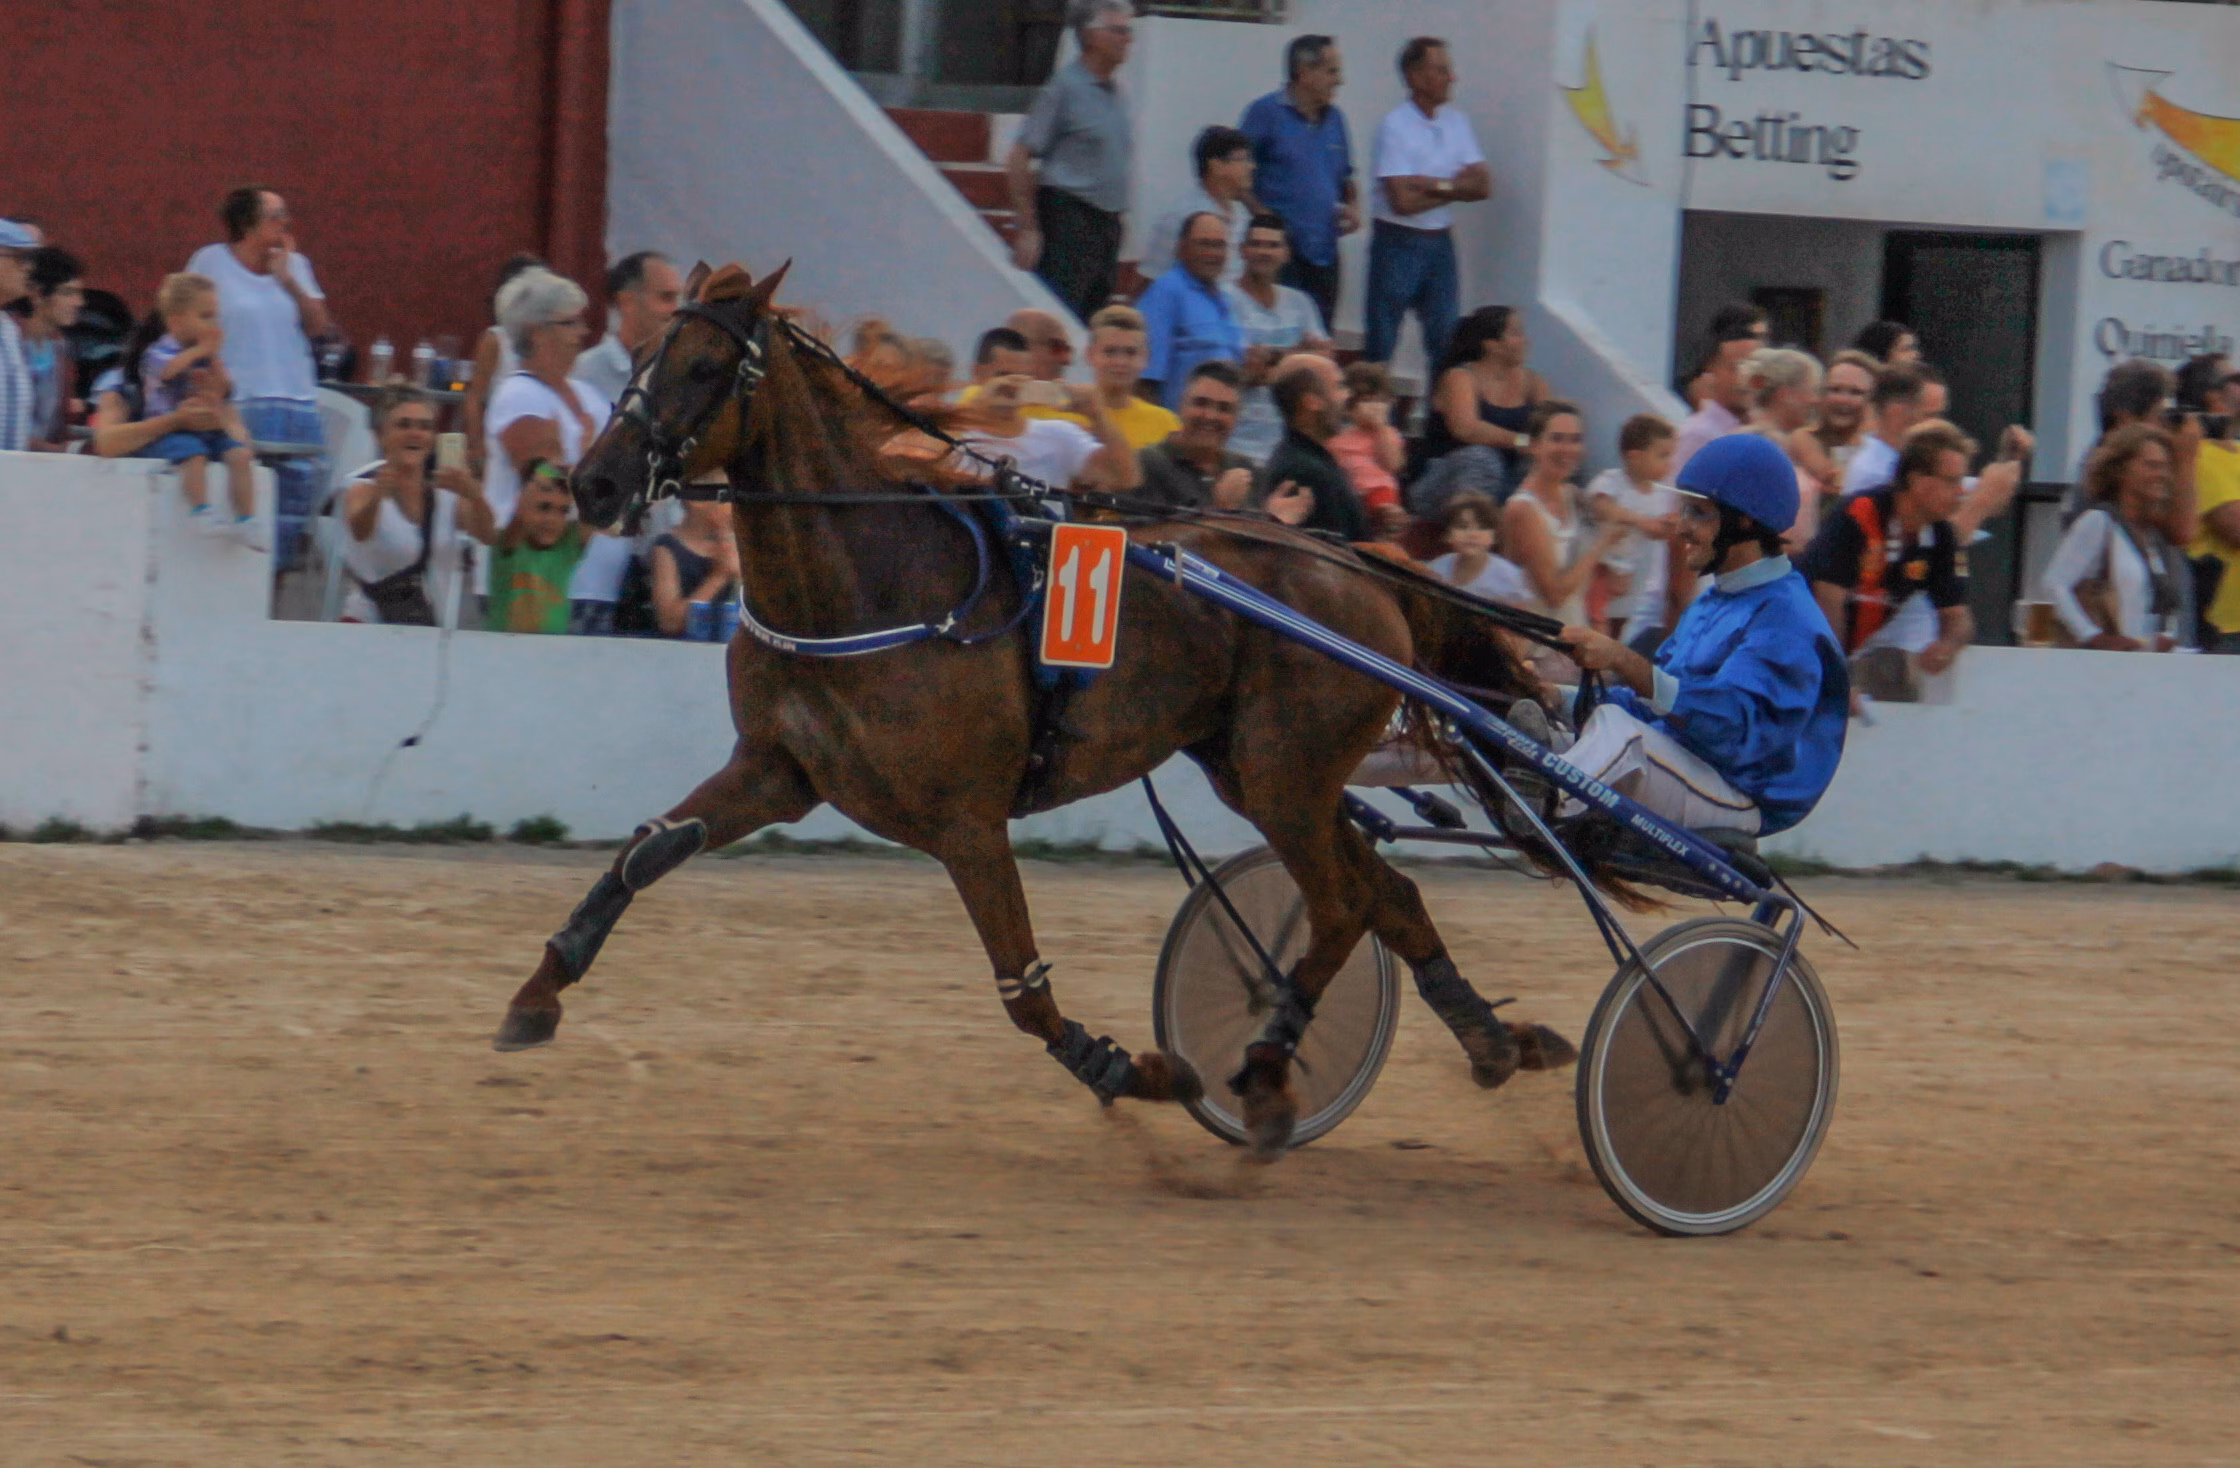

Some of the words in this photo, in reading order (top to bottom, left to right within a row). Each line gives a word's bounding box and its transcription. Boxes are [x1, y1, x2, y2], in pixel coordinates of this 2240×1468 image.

[1689, 18, 1930, 80] Apuestas
[1683, 103, 1860, 180] Betting
[1058, 545, 1111, 645] 11
[1541, 752, 1620, 808] CUSTOM
[1631, 813, 1690, 857] MULTIFLEX
